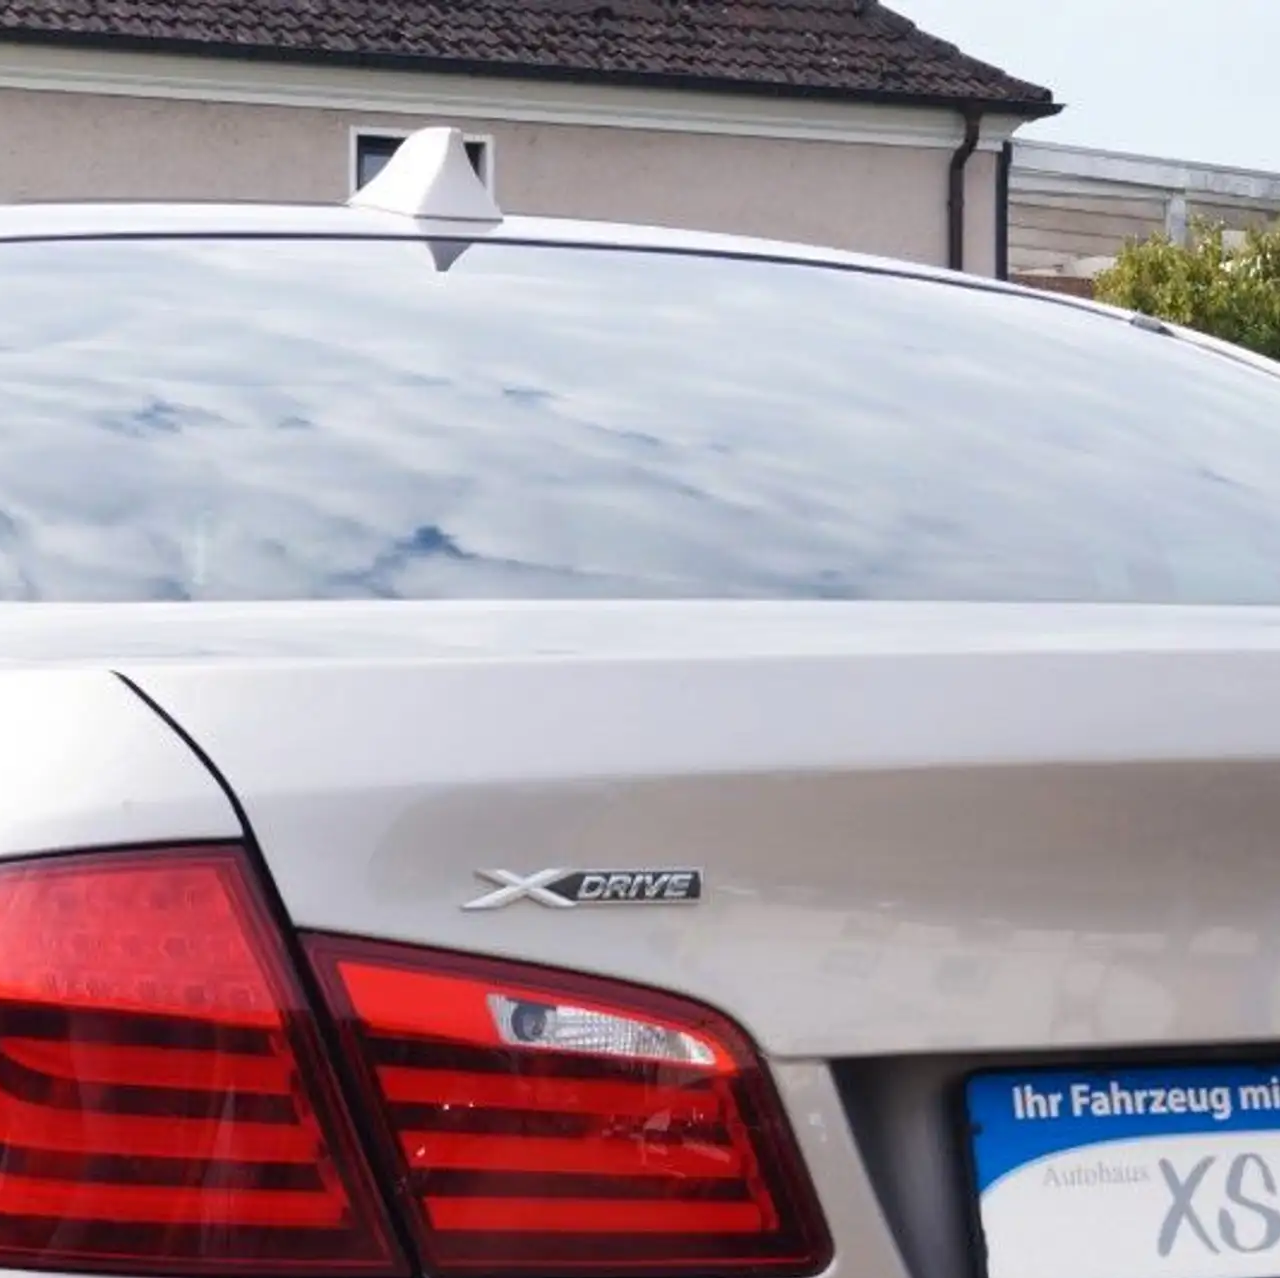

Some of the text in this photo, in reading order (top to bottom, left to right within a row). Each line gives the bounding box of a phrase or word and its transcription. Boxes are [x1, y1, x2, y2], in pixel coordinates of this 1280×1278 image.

[1013, 1084, 1061, 1119] Ihr
[1070, 1081, 1231, 1119] Fahrzeug
[1042, 1162, 1150, 1187] Autohaus
